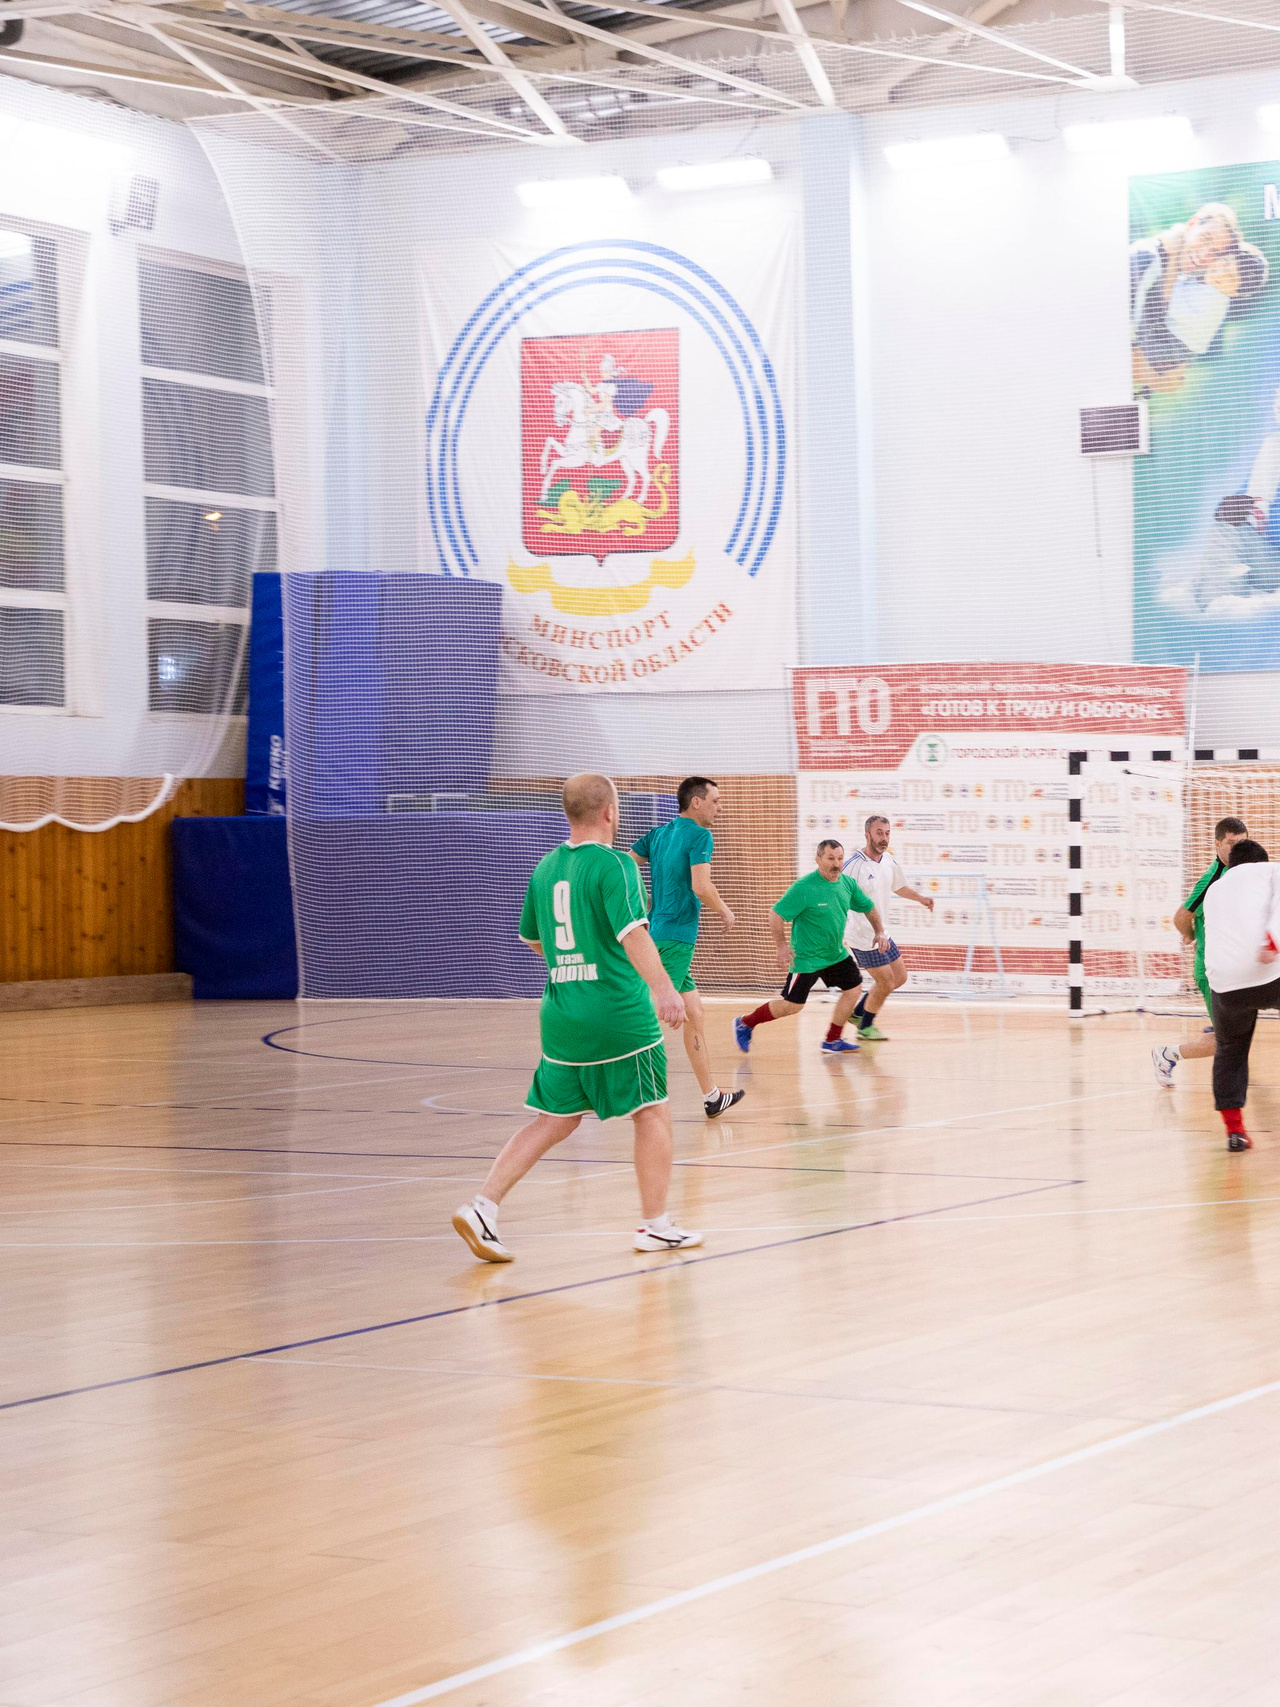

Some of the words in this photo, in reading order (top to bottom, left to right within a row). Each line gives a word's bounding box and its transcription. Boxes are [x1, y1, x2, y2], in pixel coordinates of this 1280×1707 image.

[500, 631, 628, 684] СКОВСКОЙ
[632, 601, 734, 678] ОБЛАСТИ
[528, 610, 672, 650] МИНСПОРТ
[804, 677, 892, 736] ГТО
[553, 880, 576, 951] 9
